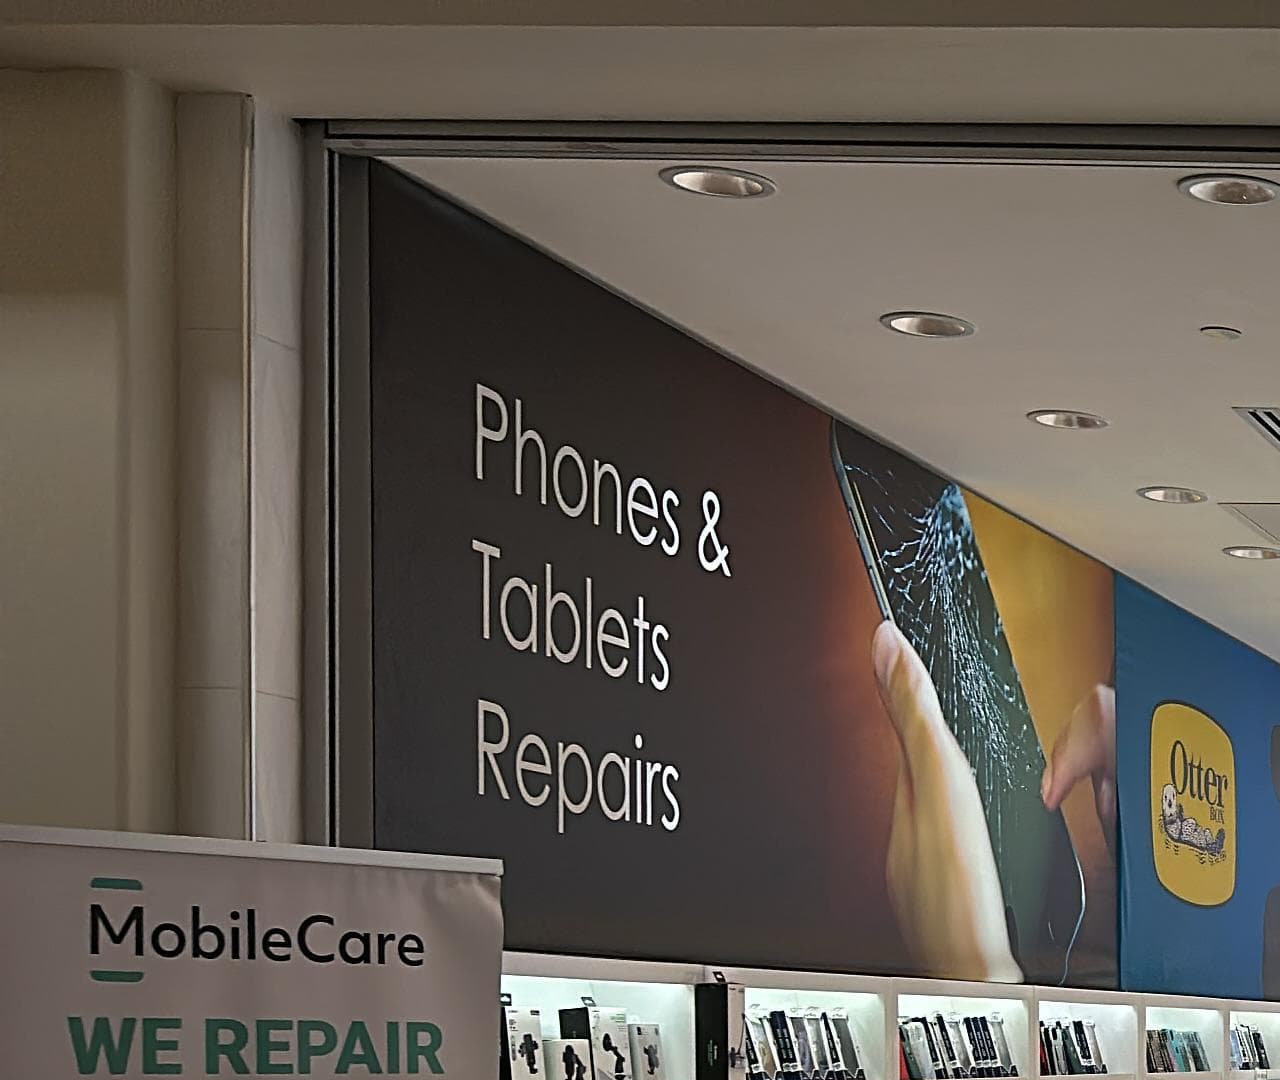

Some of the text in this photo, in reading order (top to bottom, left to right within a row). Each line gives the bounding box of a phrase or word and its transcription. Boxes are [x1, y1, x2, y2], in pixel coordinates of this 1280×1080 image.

[475, 382, 733, 577] Phones &
[471, 538, 671, 692] Tablets
[477, 698, 681, 834] Repairs
[1170, 739, 1229, 809] Otter
[89, 903, 425, 967] MobileCare
[67, 1016, 445, 1076] WE REPAIR
